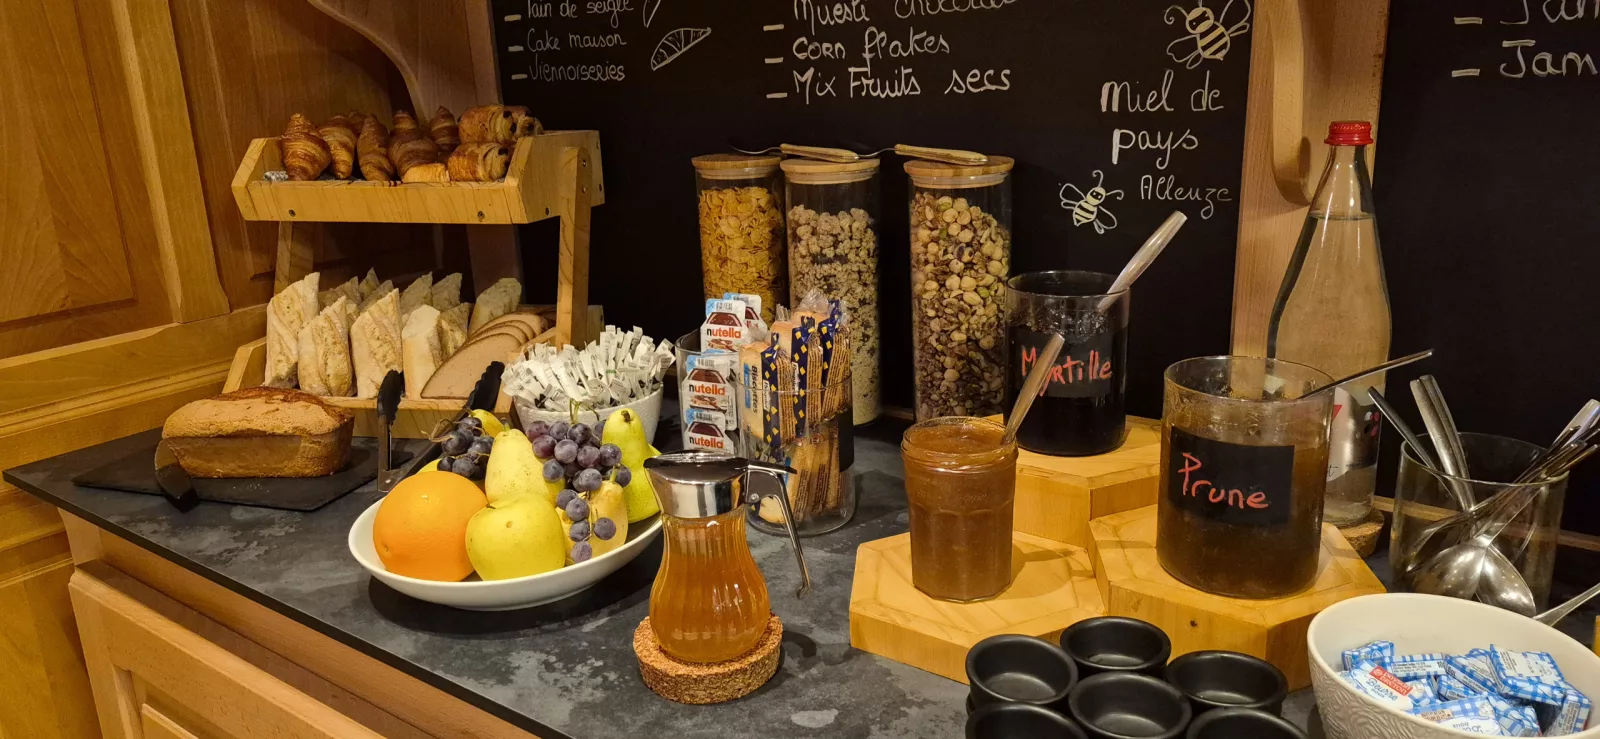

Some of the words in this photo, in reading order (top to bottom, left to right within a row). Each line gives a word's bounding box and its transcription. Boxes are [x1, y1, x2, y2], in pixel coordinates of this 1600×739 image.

[559, 0, 578, 19] de
[527, 28, 560, 53] Cake
[568, 32, 627, 48] maison
[793, 66, 837, 104] Mix
[848, 65, 921, 98] Fruits
[944, 68, 1011, 95] secs
[1100, 69, 1175, 113] Miel
[1190, 69, 1224, 112] de
[1111, 128, 1198, 169] pays
[706, 326, 742, 339] nutella
[688, 383, 726, 396] nutella
[689, 436, 724, 449] nutella
[1178, 452, 1269, 509] Prune
